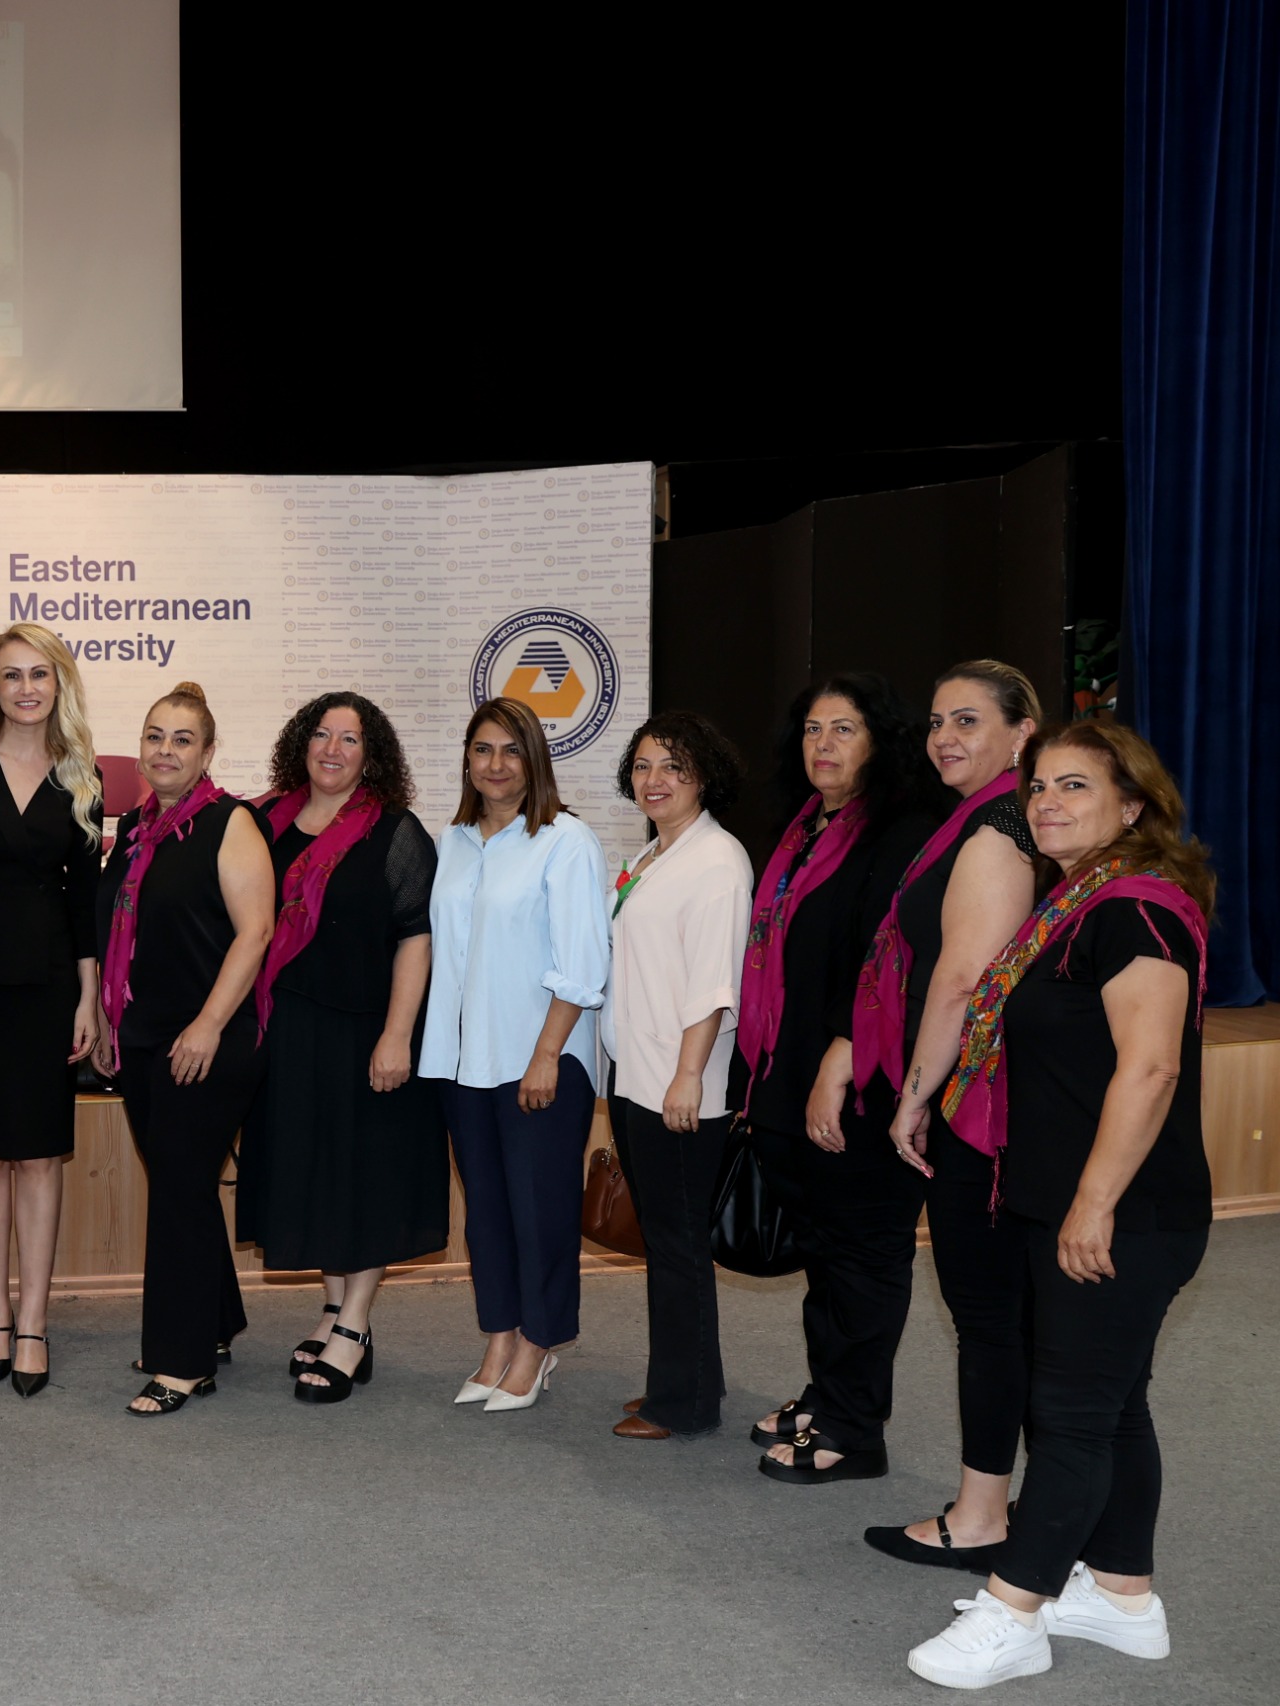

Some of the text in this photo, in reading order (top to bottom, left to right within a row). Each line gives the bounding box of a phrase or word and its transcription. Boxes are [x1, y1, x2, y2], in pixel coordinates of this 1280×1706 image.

[9, 553, 136, 582] Eastern
[9, 592, 251, 621] Mediterranean
[57, 633, 176, 667] versity
[475, 613, 613, 698] EASTERN MEDITERRANEAN UNIVERSITY
[541, 723, 557, 731] 79
[549, 701, 611, 754] ÜNİVERSİTESİ
